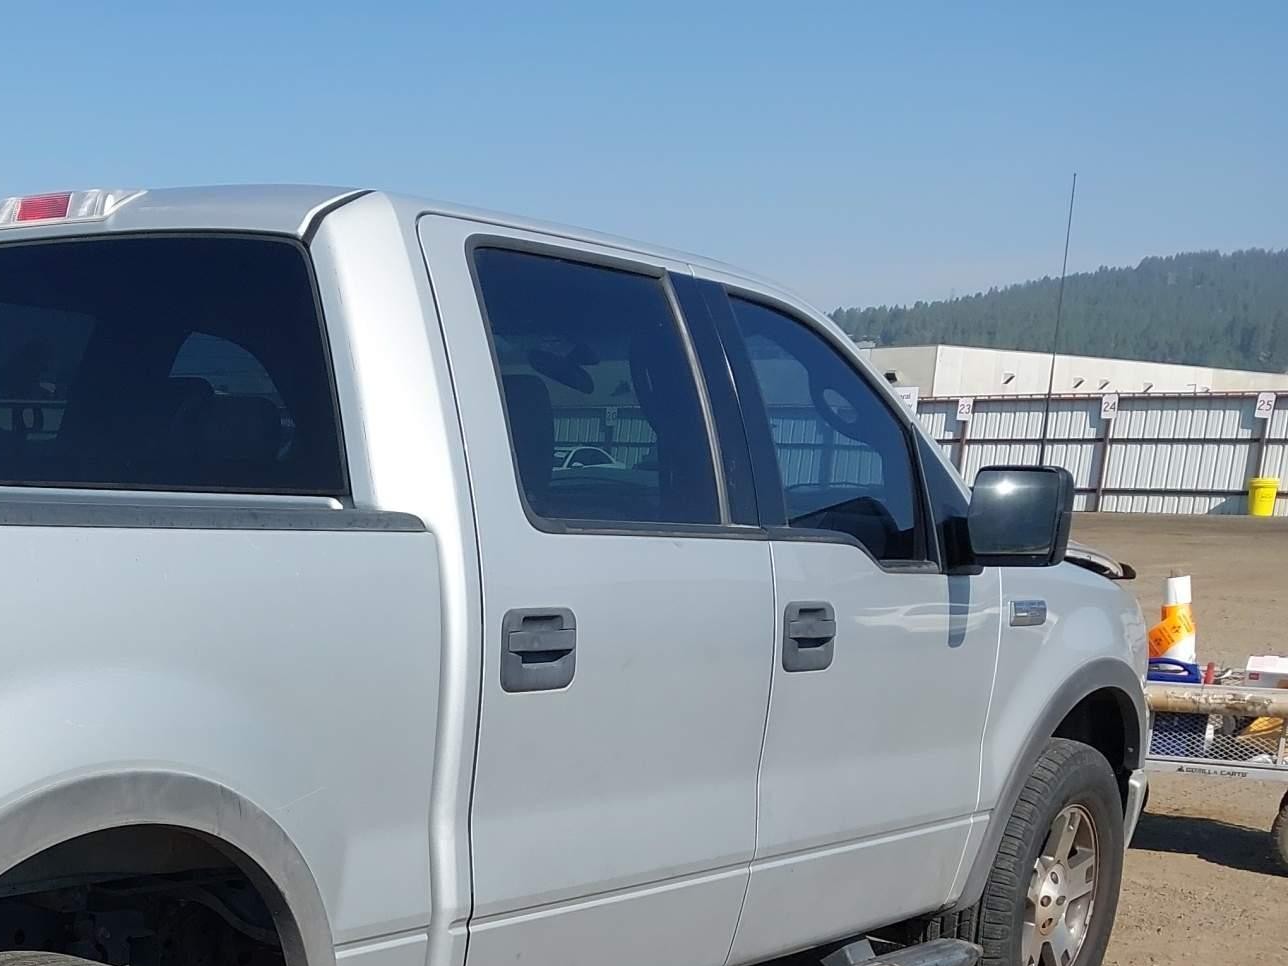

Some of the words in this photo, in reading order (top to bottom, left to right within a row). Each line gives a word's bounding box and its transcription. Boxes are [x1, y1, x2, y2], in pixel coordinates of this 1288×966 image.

[959, 404, 970, 414] 23
[1103, 402, 1117, 412] 24
[1258, 400, 1273, 411] 25
